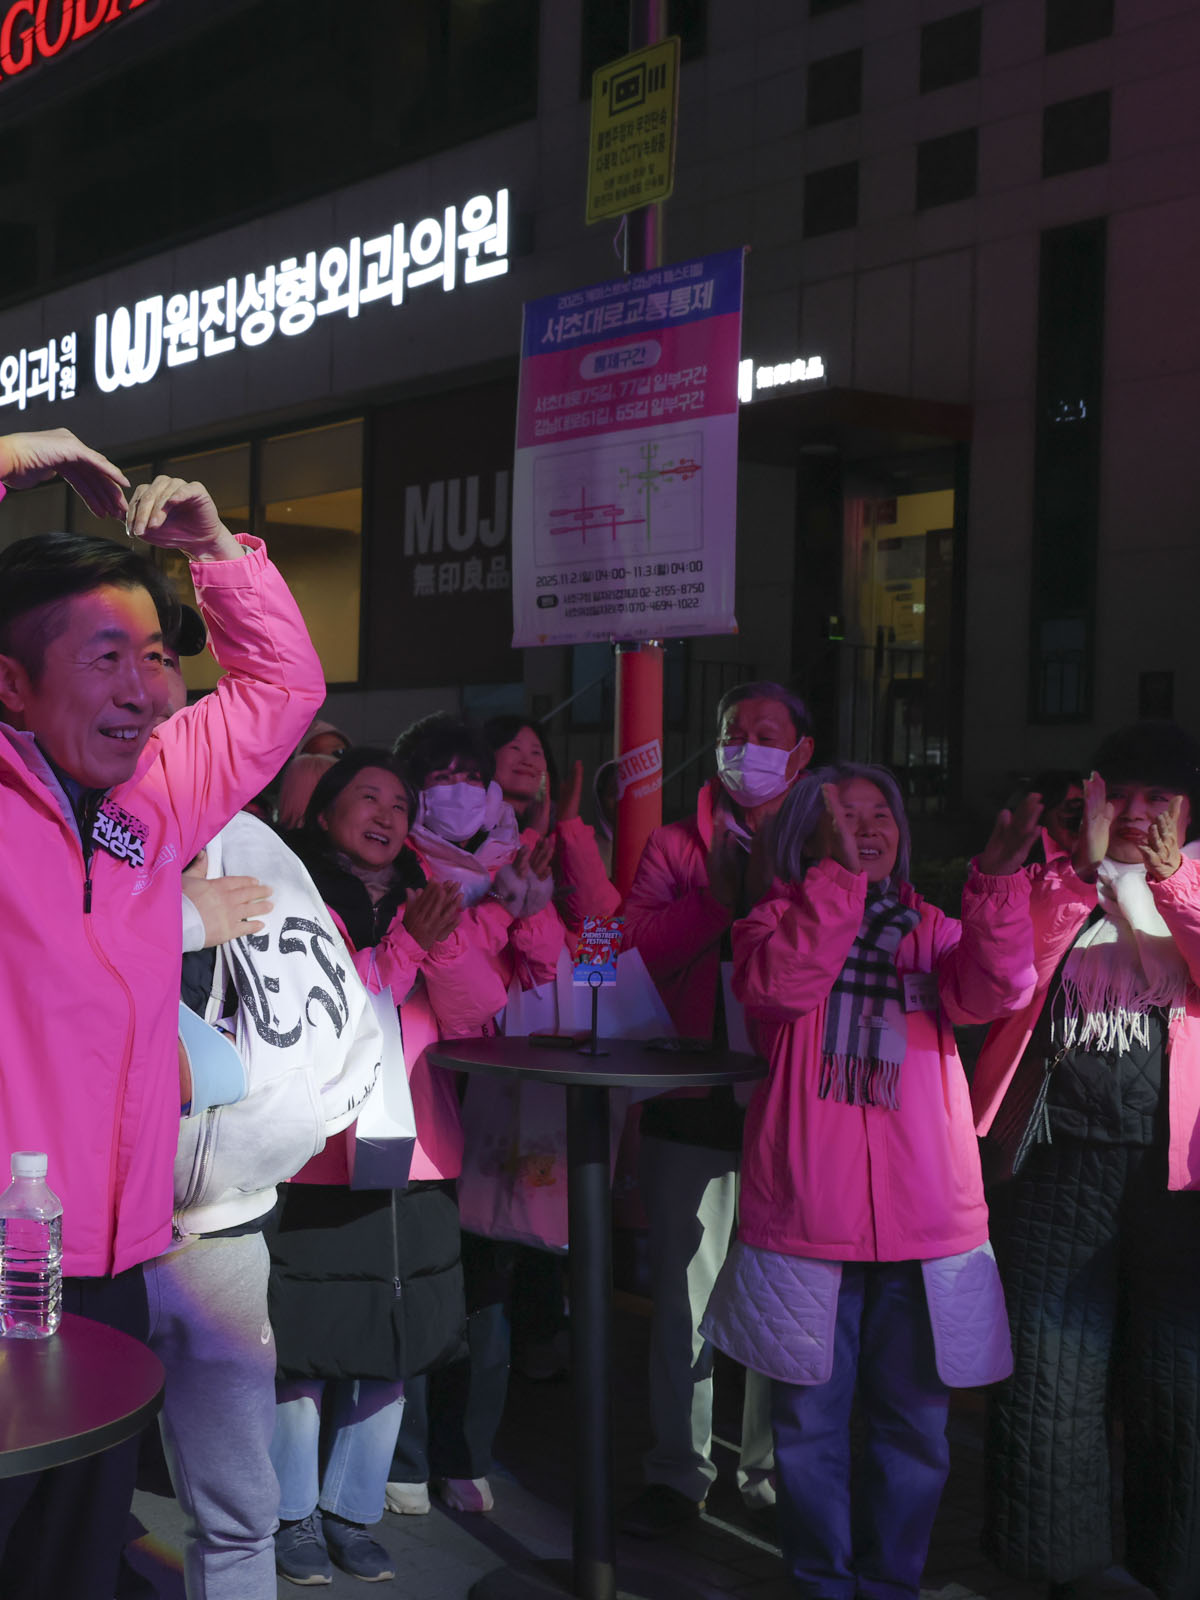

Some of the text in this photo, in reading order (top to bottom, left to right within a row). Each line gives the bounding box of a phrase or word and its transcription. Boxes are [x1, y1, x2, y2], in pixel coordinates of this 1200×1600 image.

[593, 346, 646, 374] 통제구간
[619, 375, 651, 398] 77길
[653, 365, 707, 393] 일부구간
[616, 400, 649, 423] 65길
[651, 390, 705, 418] 일부구간
[402, 470, 509, 557] MUJ
[412, 554, 510, 599] 無印良品
[671, 560, 703, 575] 04:00
[618, 746, 660, 781] STREET
[92, 810, 146, 867] 전성수
